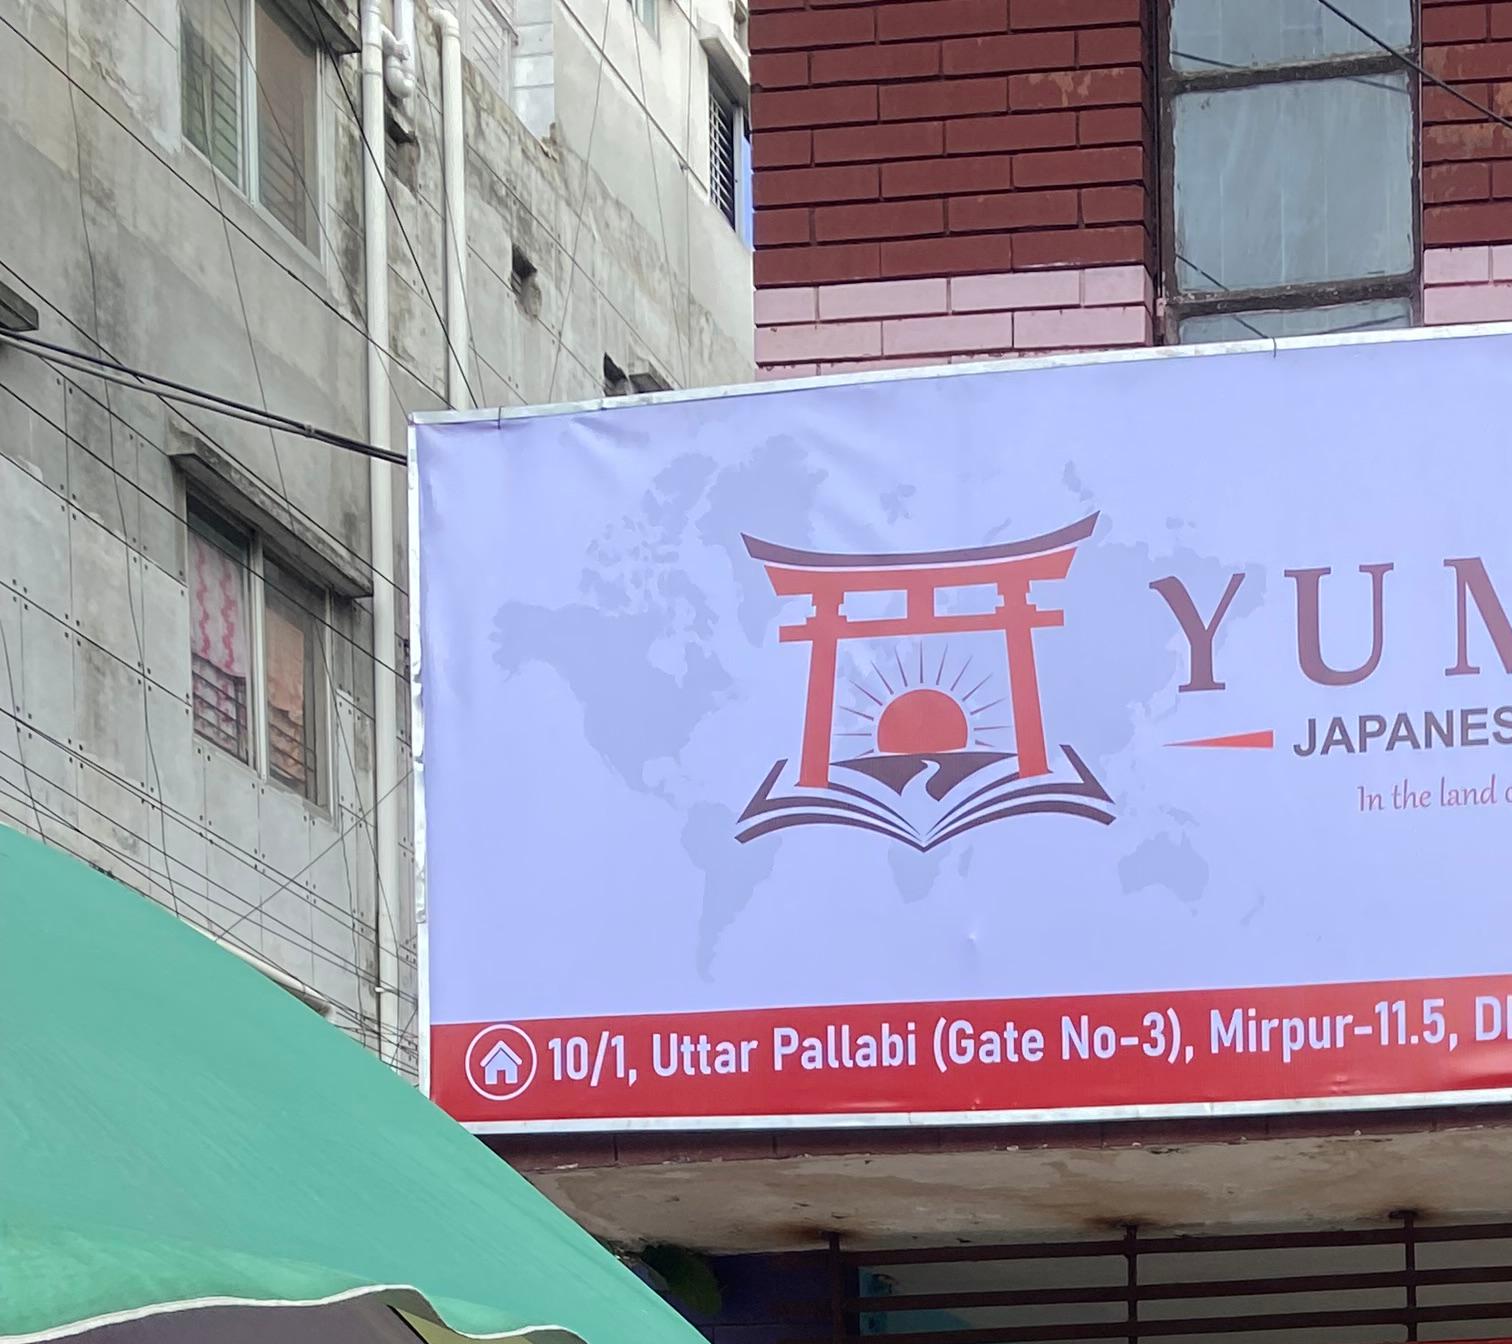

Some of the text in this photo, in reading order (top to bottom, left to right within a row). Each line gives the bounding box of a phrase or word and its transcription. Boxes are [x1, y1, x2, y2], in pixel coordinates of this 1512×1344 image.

[1357, 785, 1386, 812] In
[1391, 780, 1432, 808] the
[1438, 775, 1497, 808] land
[548, 1031, 637, 1087] 10/1,
[653, 1030, 758, 1077] Uttar
[774, 1022, 917, 1072] Pallabi
[933, 1016, 1044, 1074] (Gate
[1059, 1008, 1195, 1064] No-3),
[1210, 998, 1458, 1063] Mirpur-11.5,
